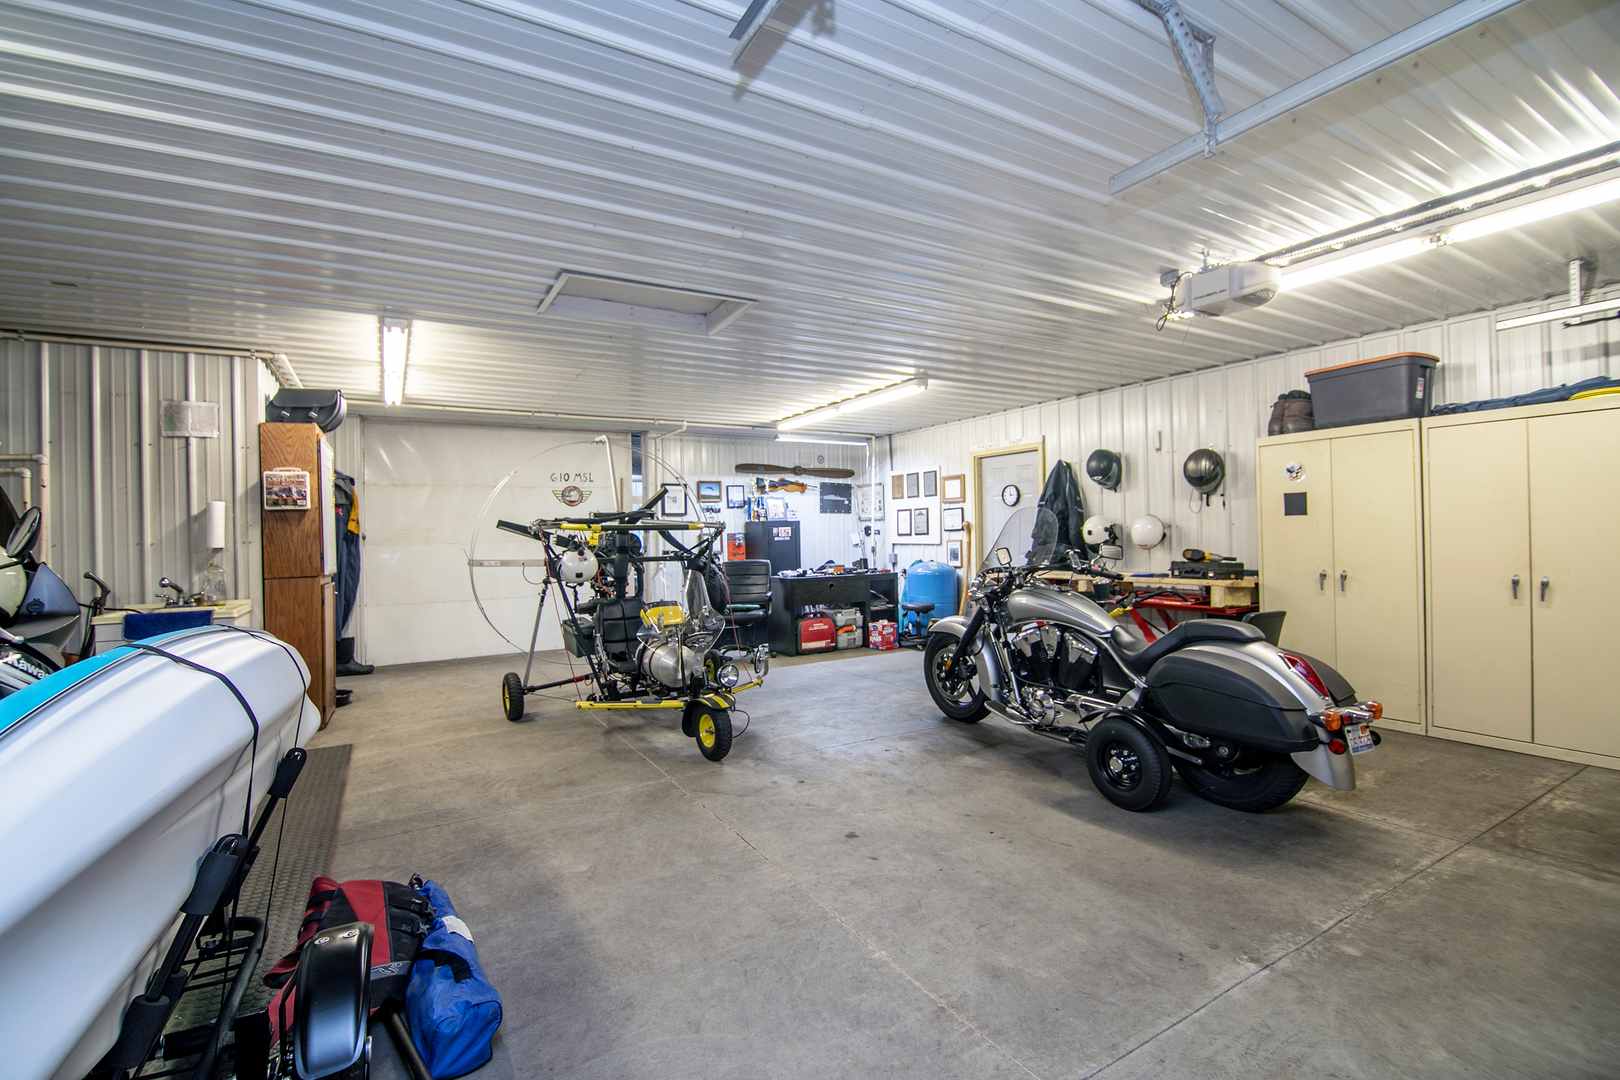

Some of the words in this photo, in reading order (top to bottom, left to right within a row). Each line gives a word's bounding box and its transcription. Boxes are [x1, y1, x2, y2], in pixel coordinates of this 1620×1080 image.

[1193, 288, 1227, 301] CHAMBERLAIN
[1008, 437, 1023, 446] SHOP
[550, 472, 570, 483] 610
[573, 472, 594, 483] MSL
